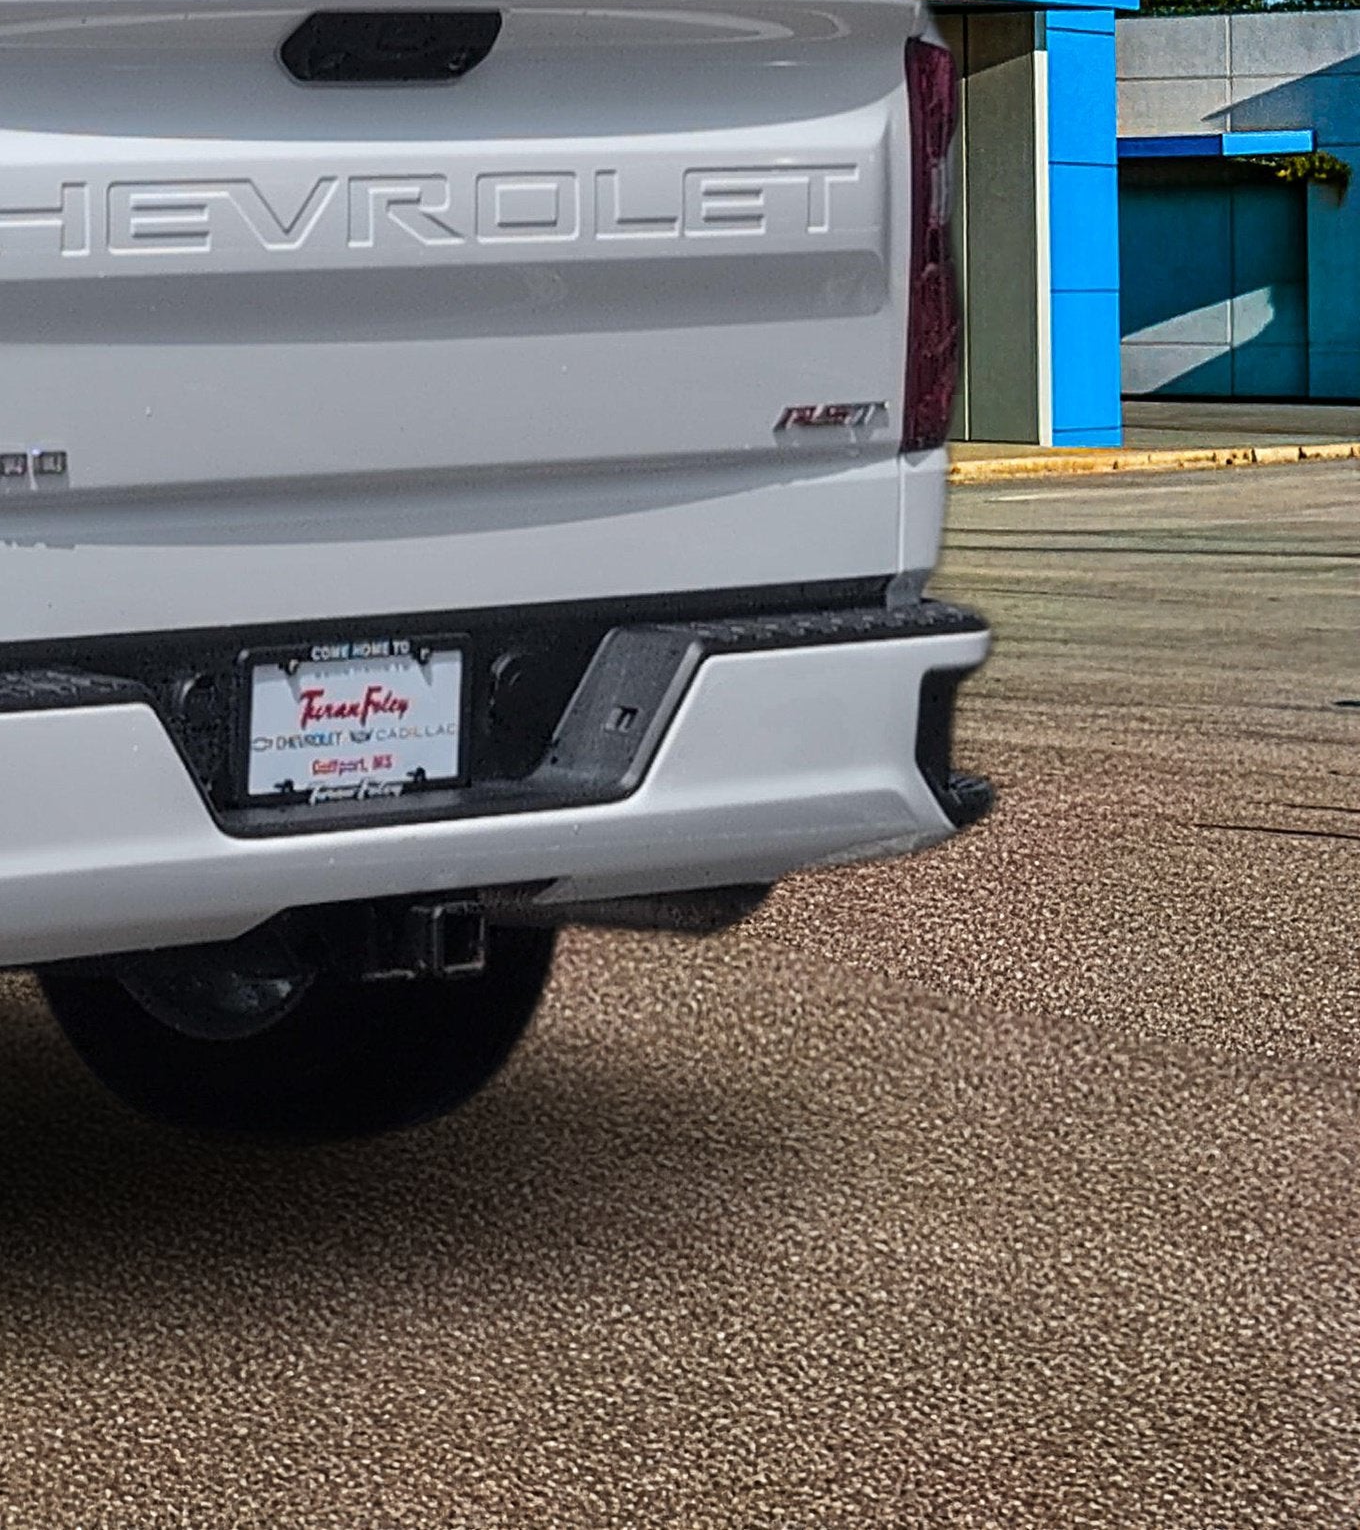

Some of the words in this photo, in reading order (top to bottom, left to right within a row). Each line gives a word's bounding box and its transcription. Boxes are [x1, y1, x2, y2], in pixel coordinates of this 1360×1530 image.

[311, 644, 349, 661] COME
[352, 641, 389, 658] HOME
[392, 638, 410, 656] TO
[376, 722, 457, 742] CADILLAC
